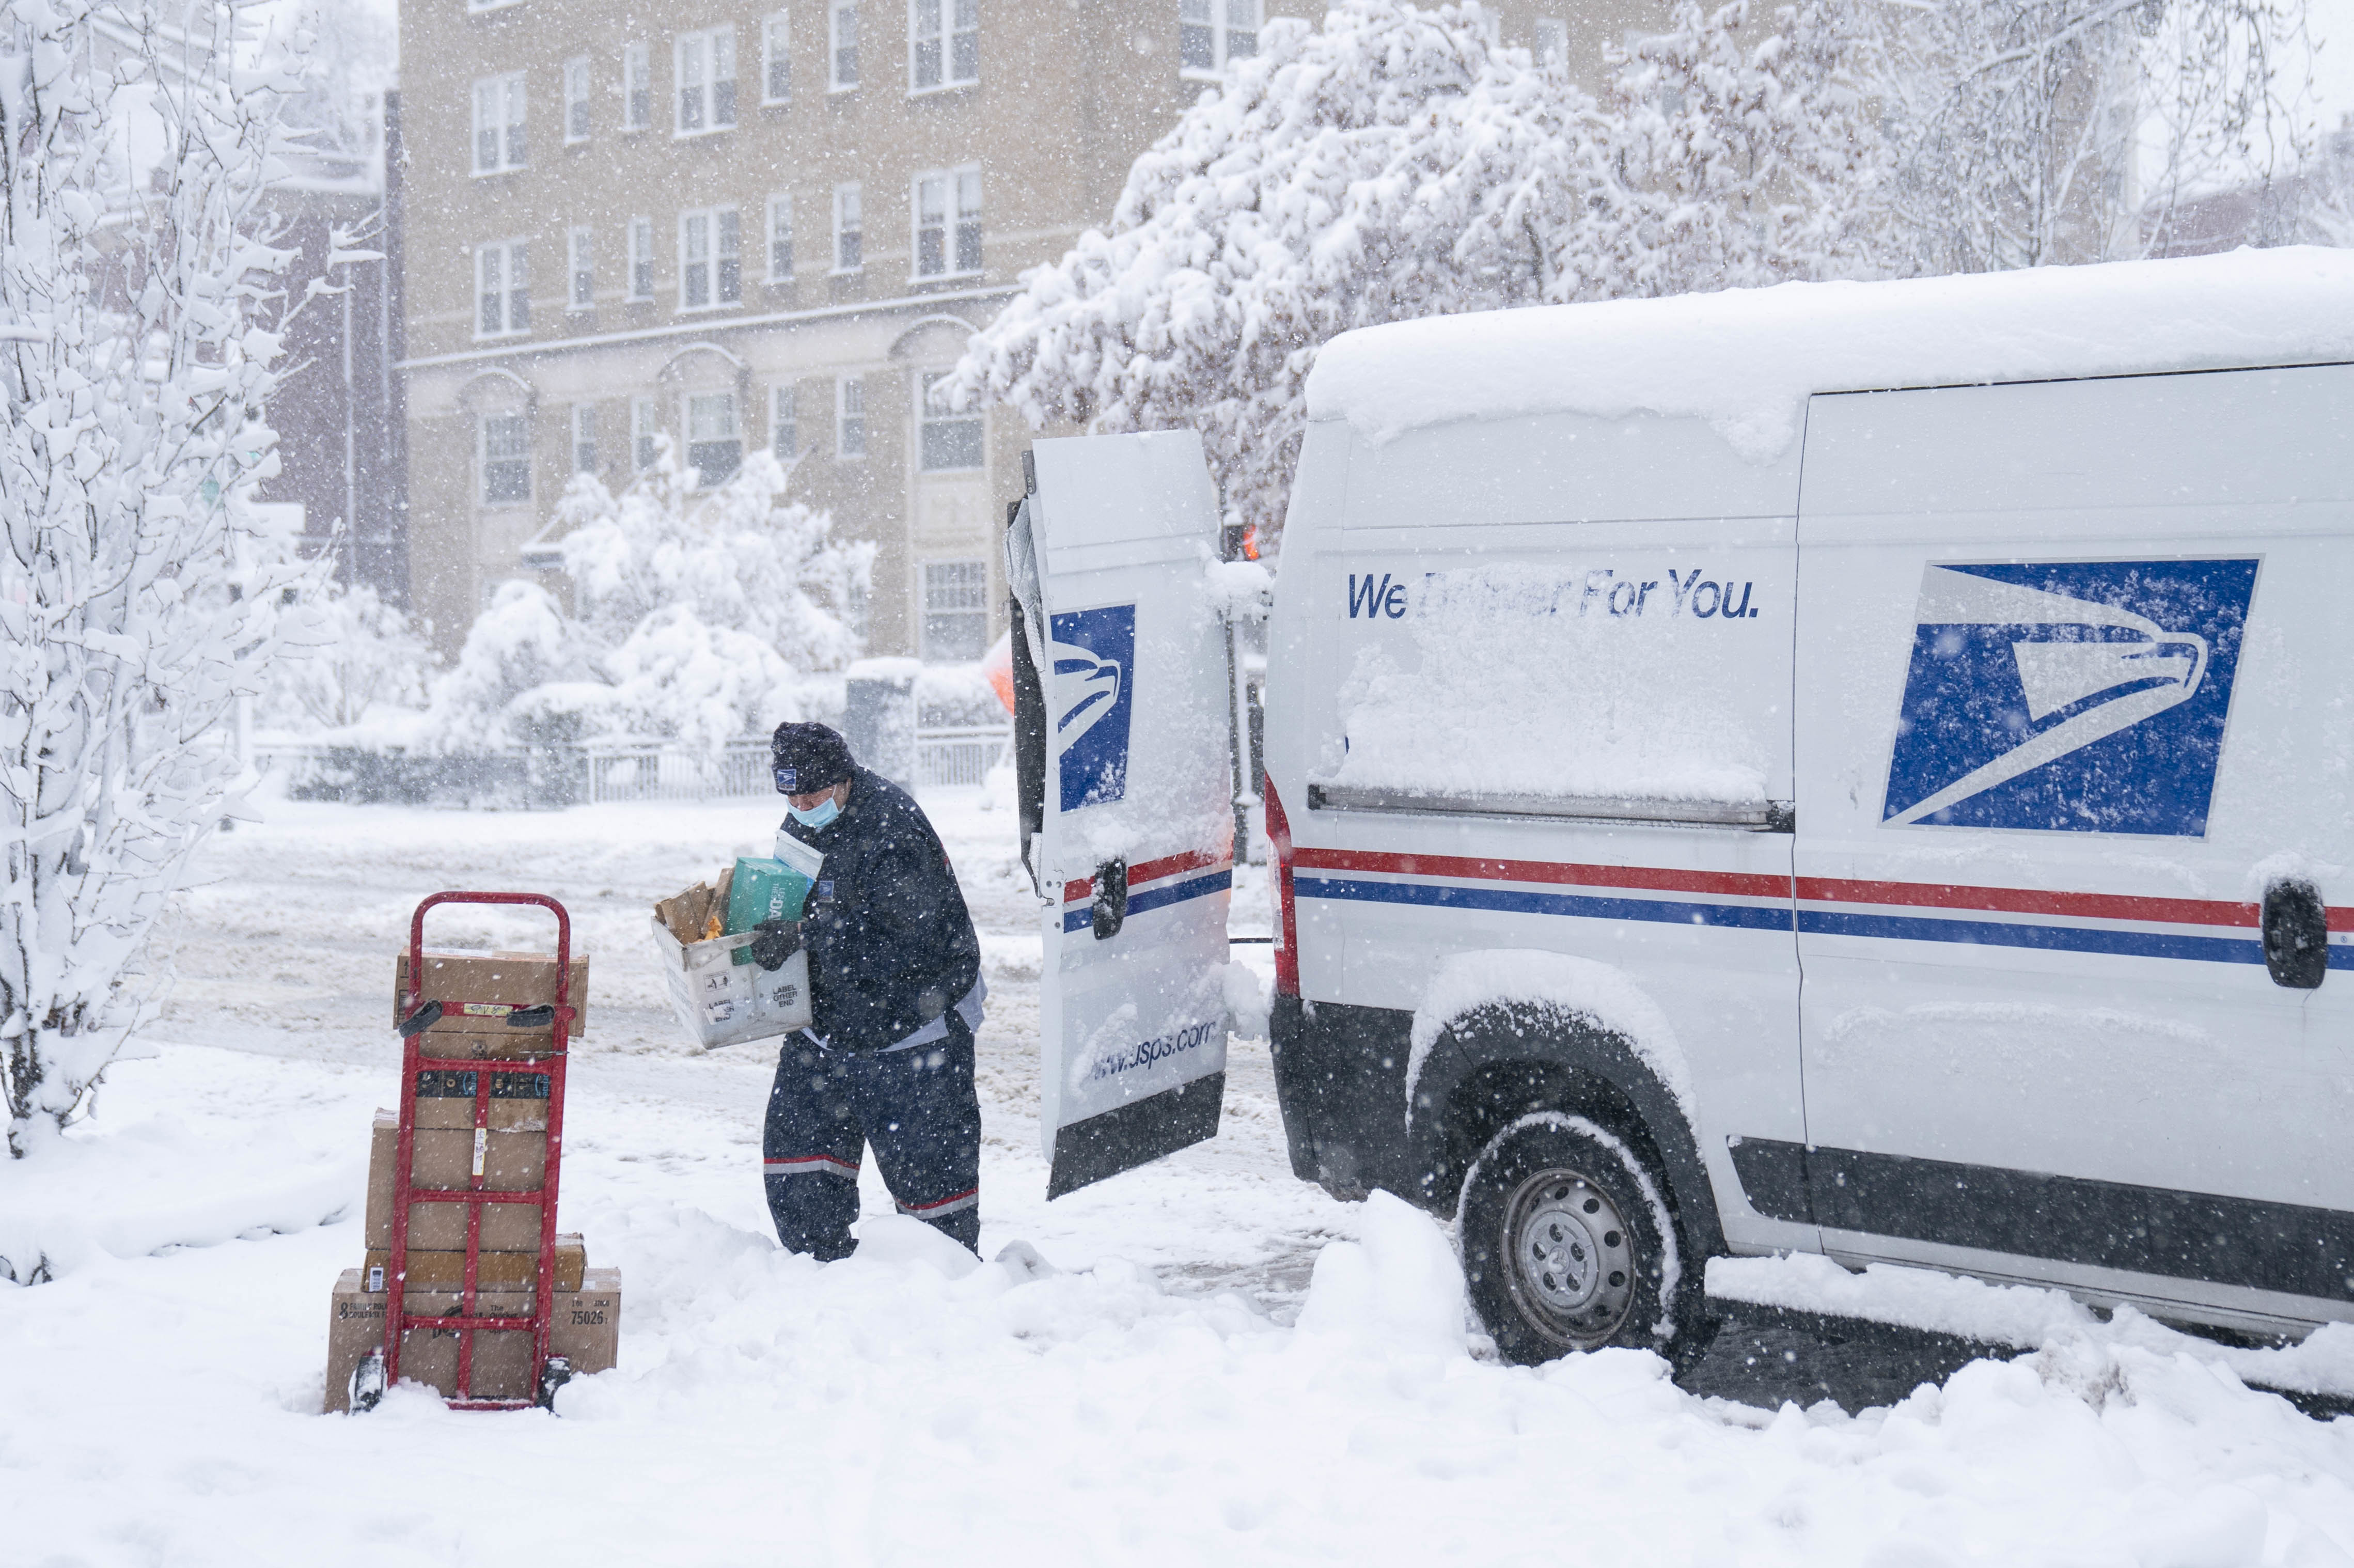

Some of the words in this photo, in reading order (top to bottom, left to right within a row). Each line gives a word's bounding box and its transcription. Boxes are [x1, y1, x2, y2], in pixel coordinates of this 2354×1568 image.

[1348, 573, 1407, 619] We
[1579, 569, 1658, 619] For
[1668, 569, 1759, 619] You.
[773, 984, 796, 995] LABEL
[773, 991, 798, 1002] OTHER
[779, 999, 794, 1008] END
[339, 1302, 348, 1319] 8
[571, 1310, 604, 1325] 75026
